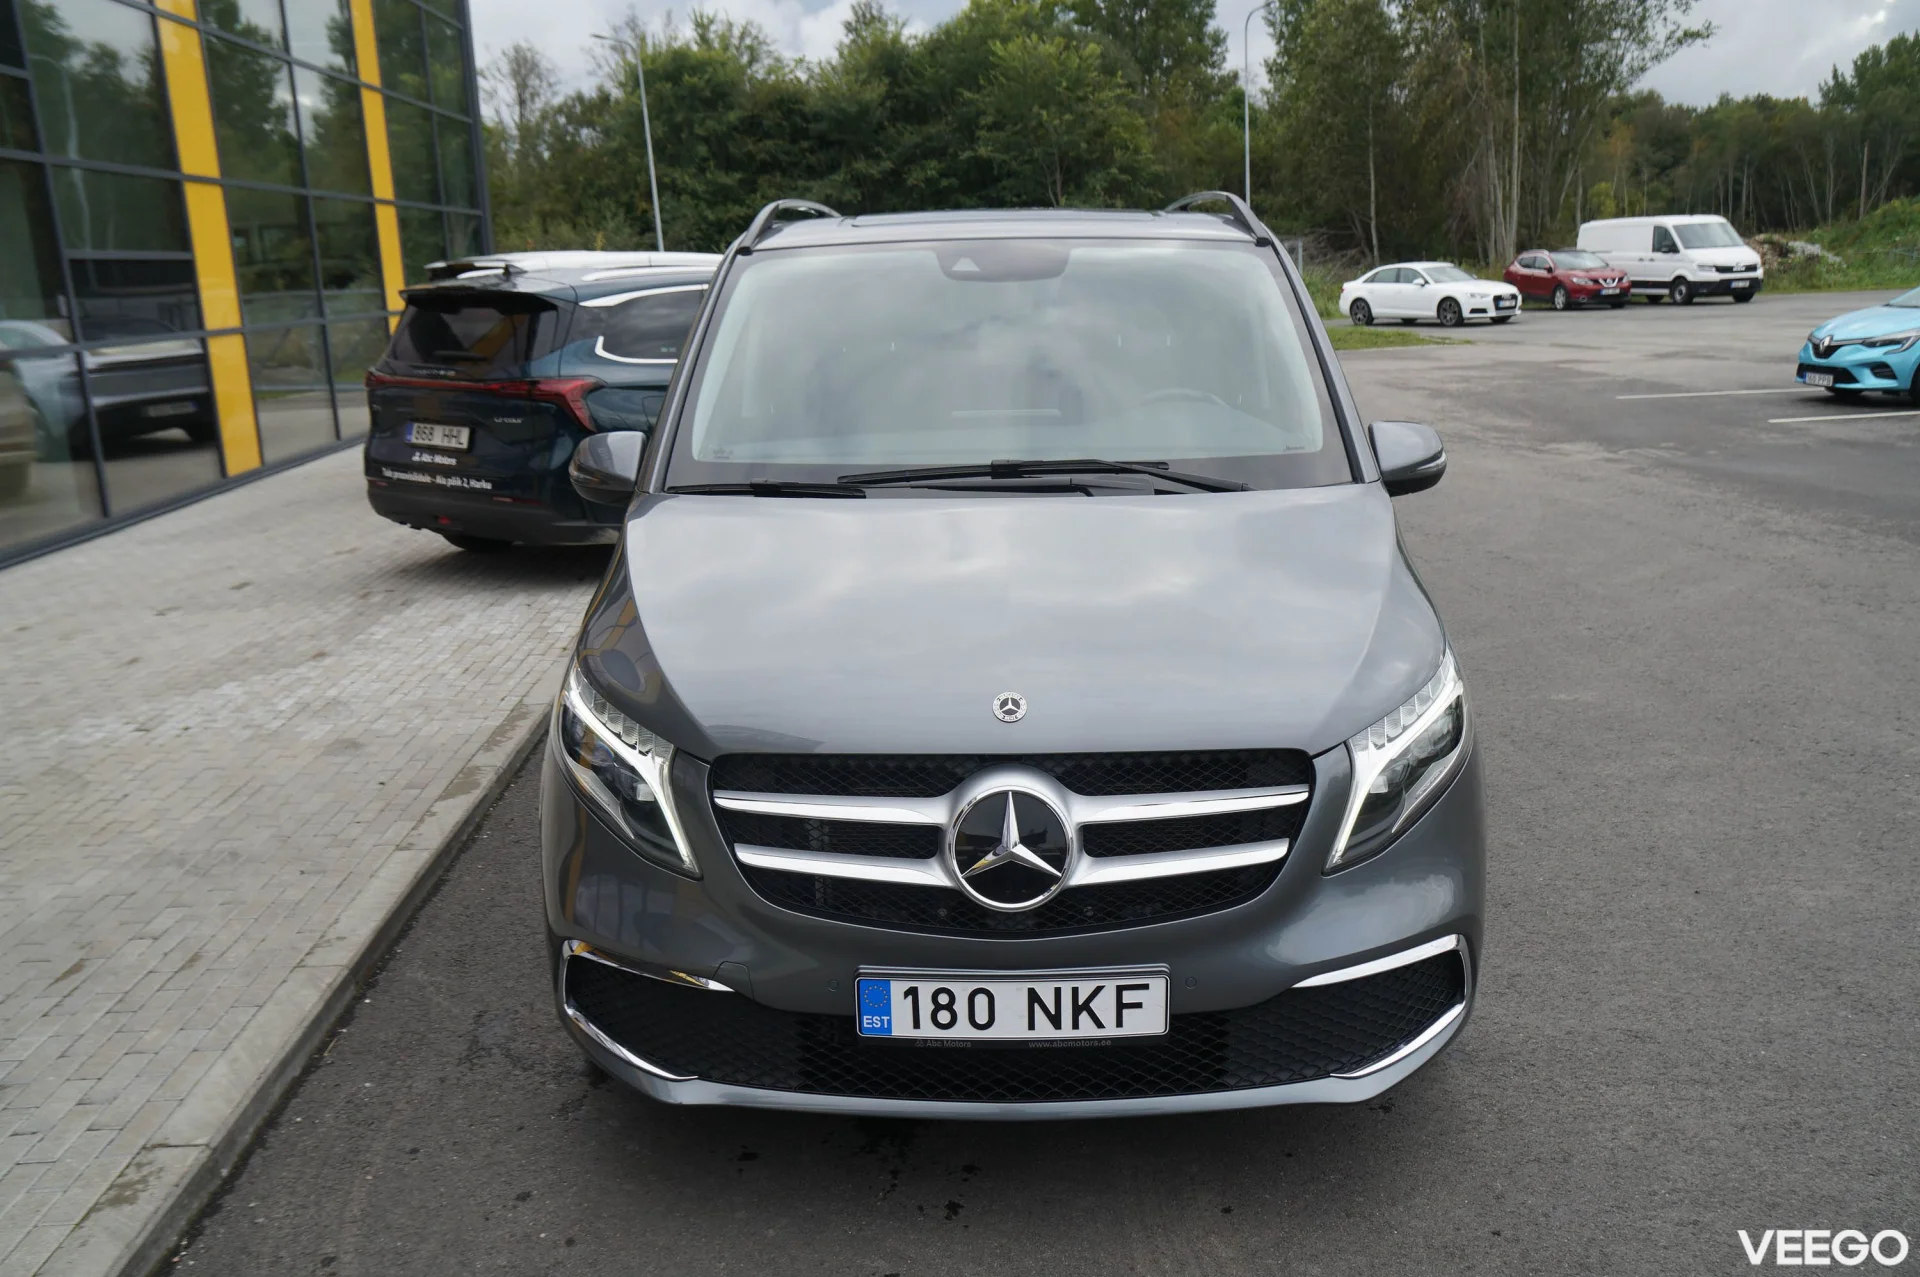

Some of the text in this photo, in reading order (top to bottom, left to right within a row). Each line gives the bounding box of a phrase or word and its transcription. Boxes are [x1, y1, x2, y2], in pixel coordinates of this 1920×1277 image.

[903, 983, 1150, 1031] 180 NKF
[863, 1016, 890, 1028] EST
[926, 1039, 972, 1048] Abc Motors
[1028, 1039, 1112, 1048] www.abcmotors.ee
